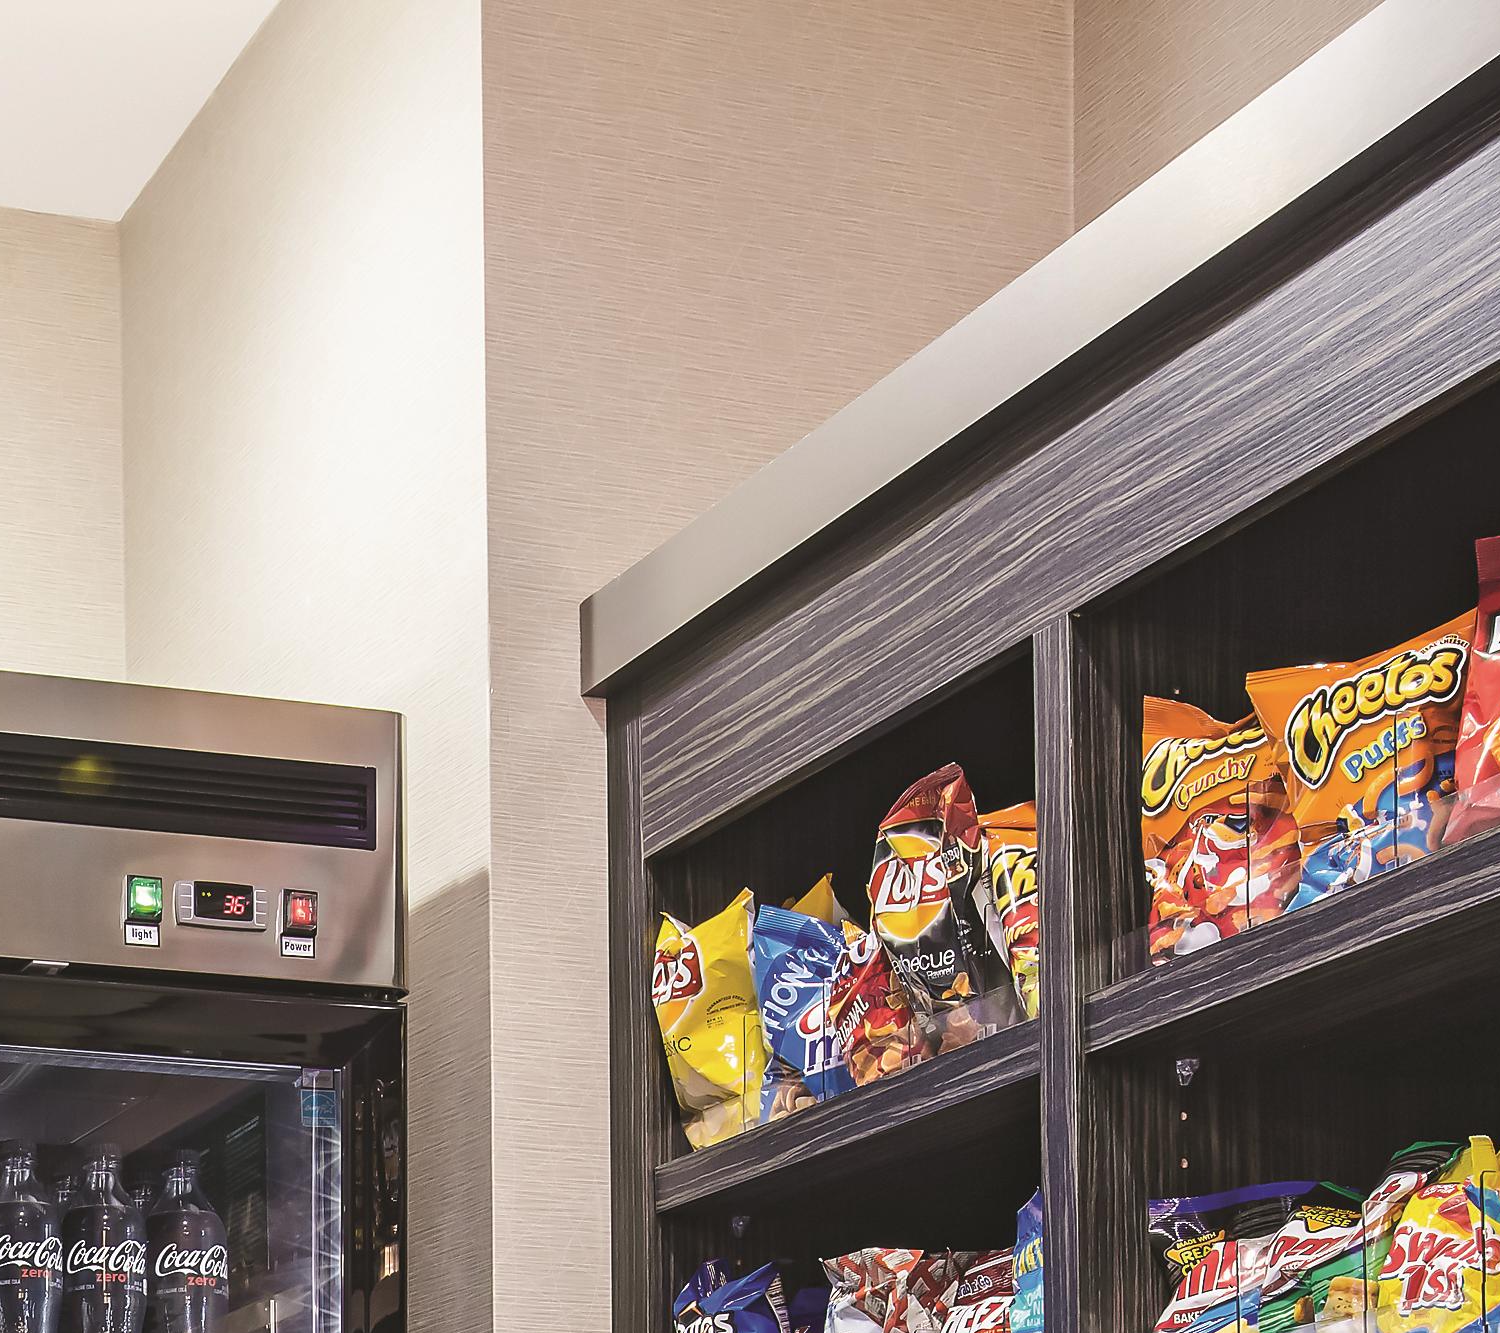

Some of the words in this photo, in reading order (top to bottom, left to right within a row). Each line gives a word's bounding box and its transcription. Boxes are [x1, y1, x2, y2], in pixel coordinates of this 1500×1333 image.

[1290, 650, 1462, 784] Cheetos
[1346, 713, 1427, 781] Puffs
[1175, 751, 1256, 808] Crunchy
[874, 855, 948, 913] Lay's
[223, 894, 246, 915] 36
[130, 927, 153, 943] light
[283, 939, 313, 954] Power
[1295, 1210, 1353, 1228] CHEESE
[20, 1267, 53, 1279] zero
[96, 1273, 129, 1285] zero
[187, 1275, 219, 1288] zero
